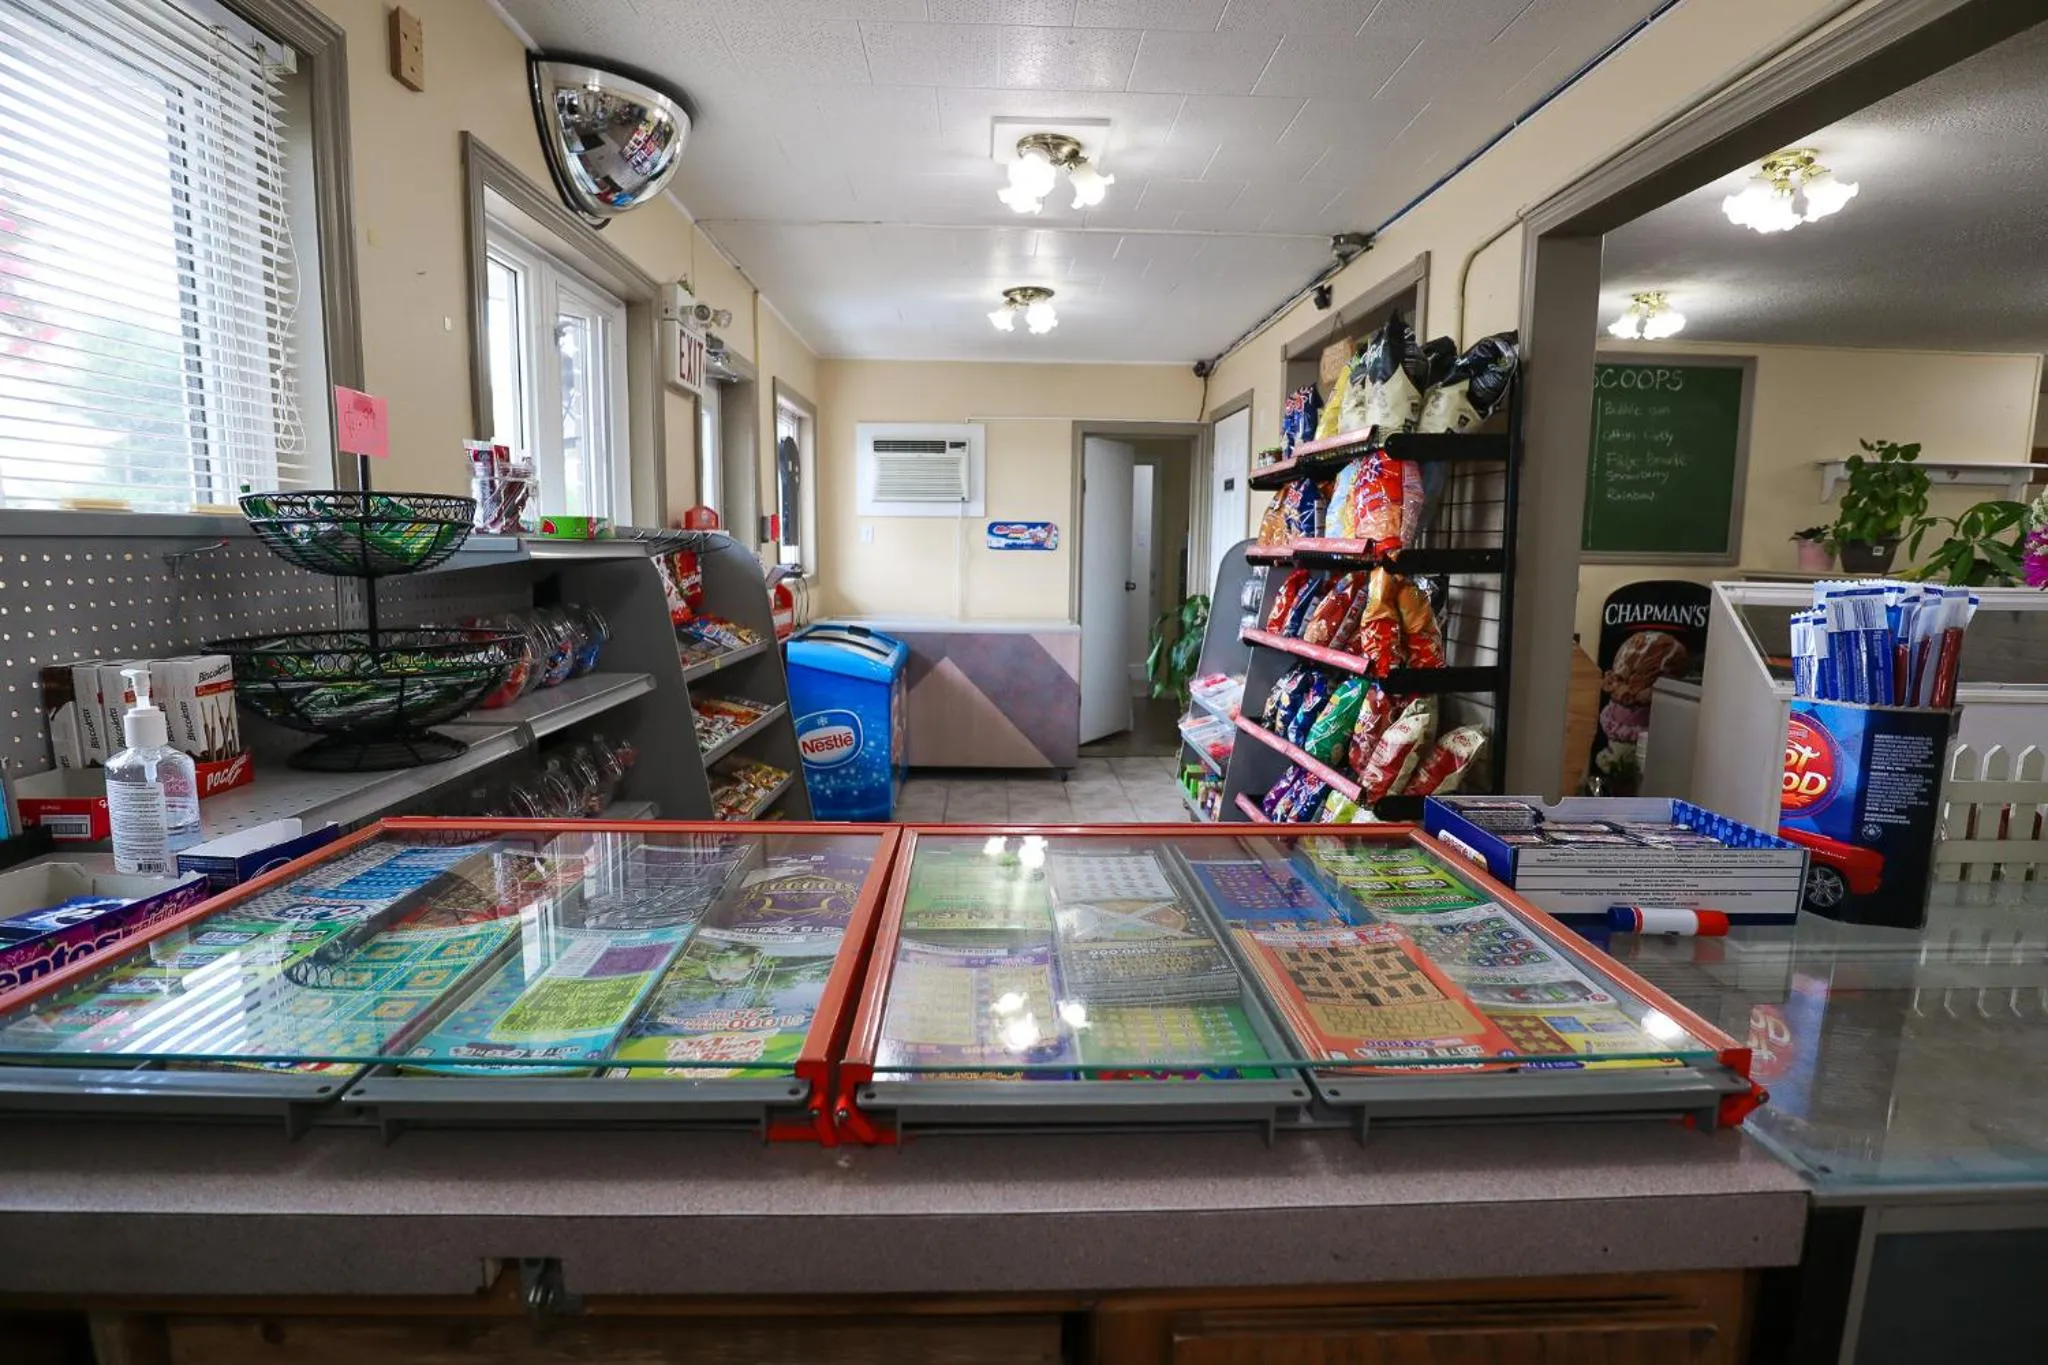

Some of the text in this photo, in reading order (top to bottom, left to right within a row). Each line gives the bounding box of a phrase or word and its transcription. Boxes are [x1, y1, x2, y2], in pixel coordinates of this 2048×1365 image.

[679, 328, 704, 388] EXIT
[1604, 603, 1707, 627] CHAPMAN'S
[0, 927, 124, 995] entos
